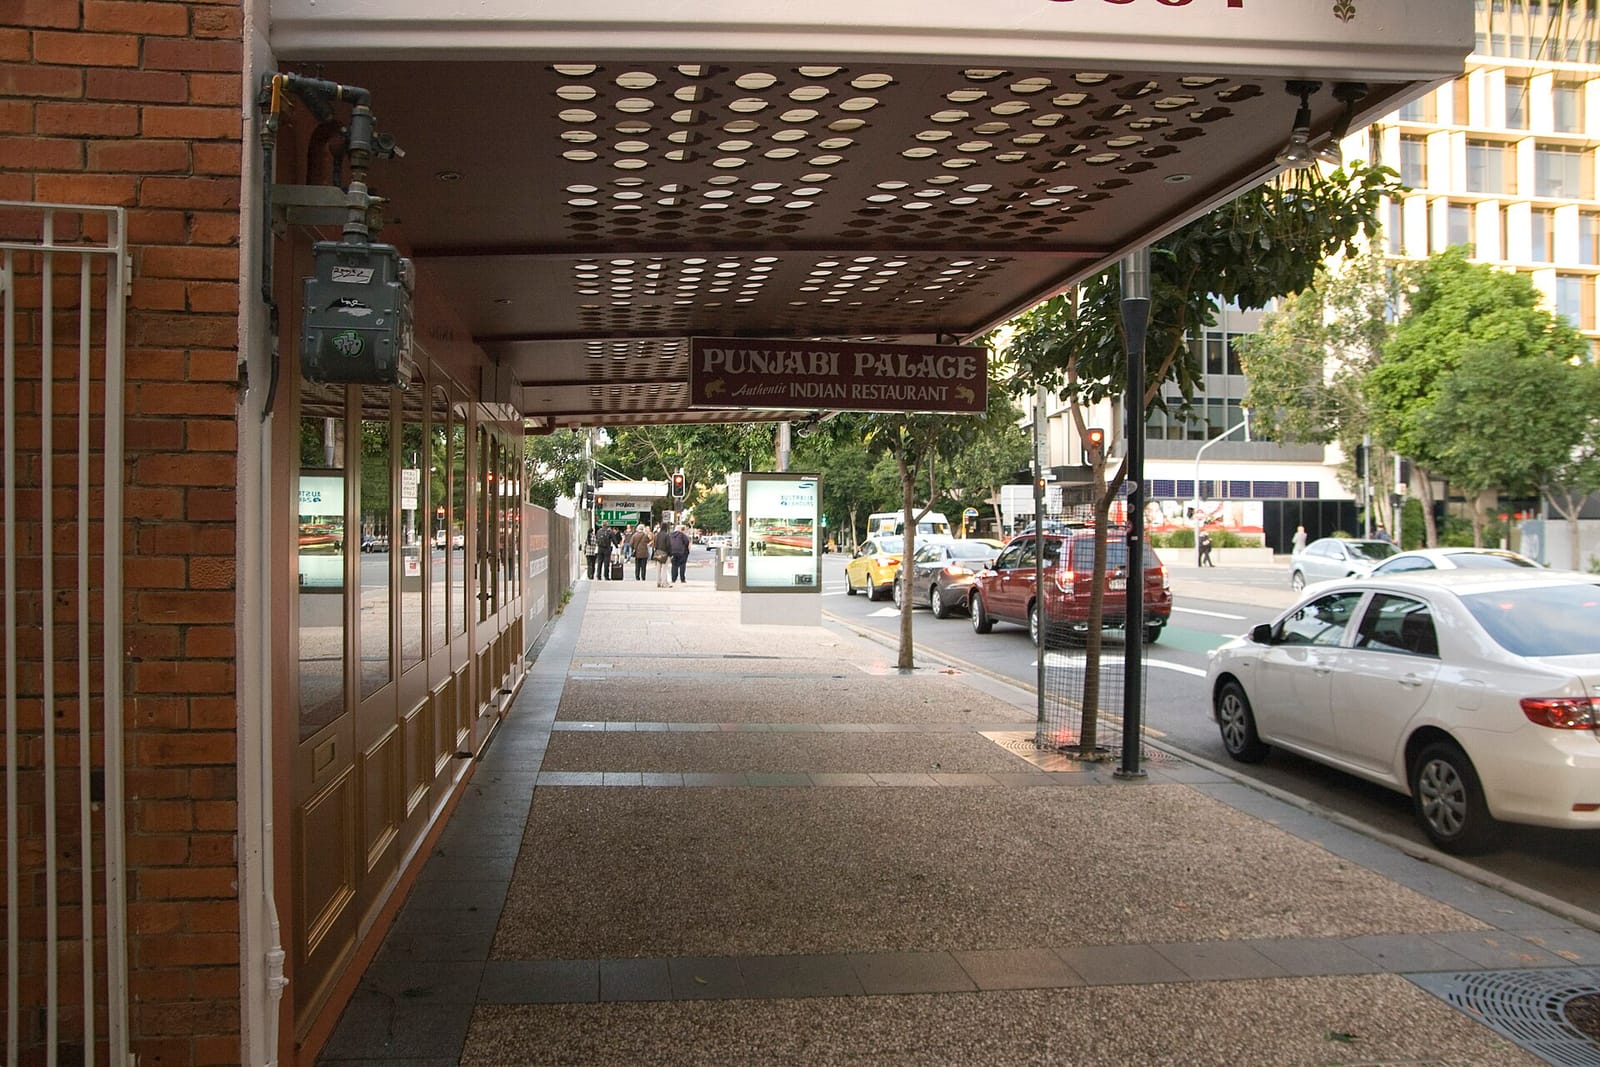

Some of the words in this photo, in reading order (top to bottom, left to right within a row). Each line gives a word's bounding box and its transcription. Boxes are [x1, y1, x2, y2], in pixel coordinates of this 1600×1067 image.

[702, 348, 839, 376] PUNJABI
[853, 352, 977, 380] PALACE
[731, 382, 788, 398] Authentic
[789, 382, 847, 399] INDIAN
[852, 383, 949, 401] RESTAURANT
